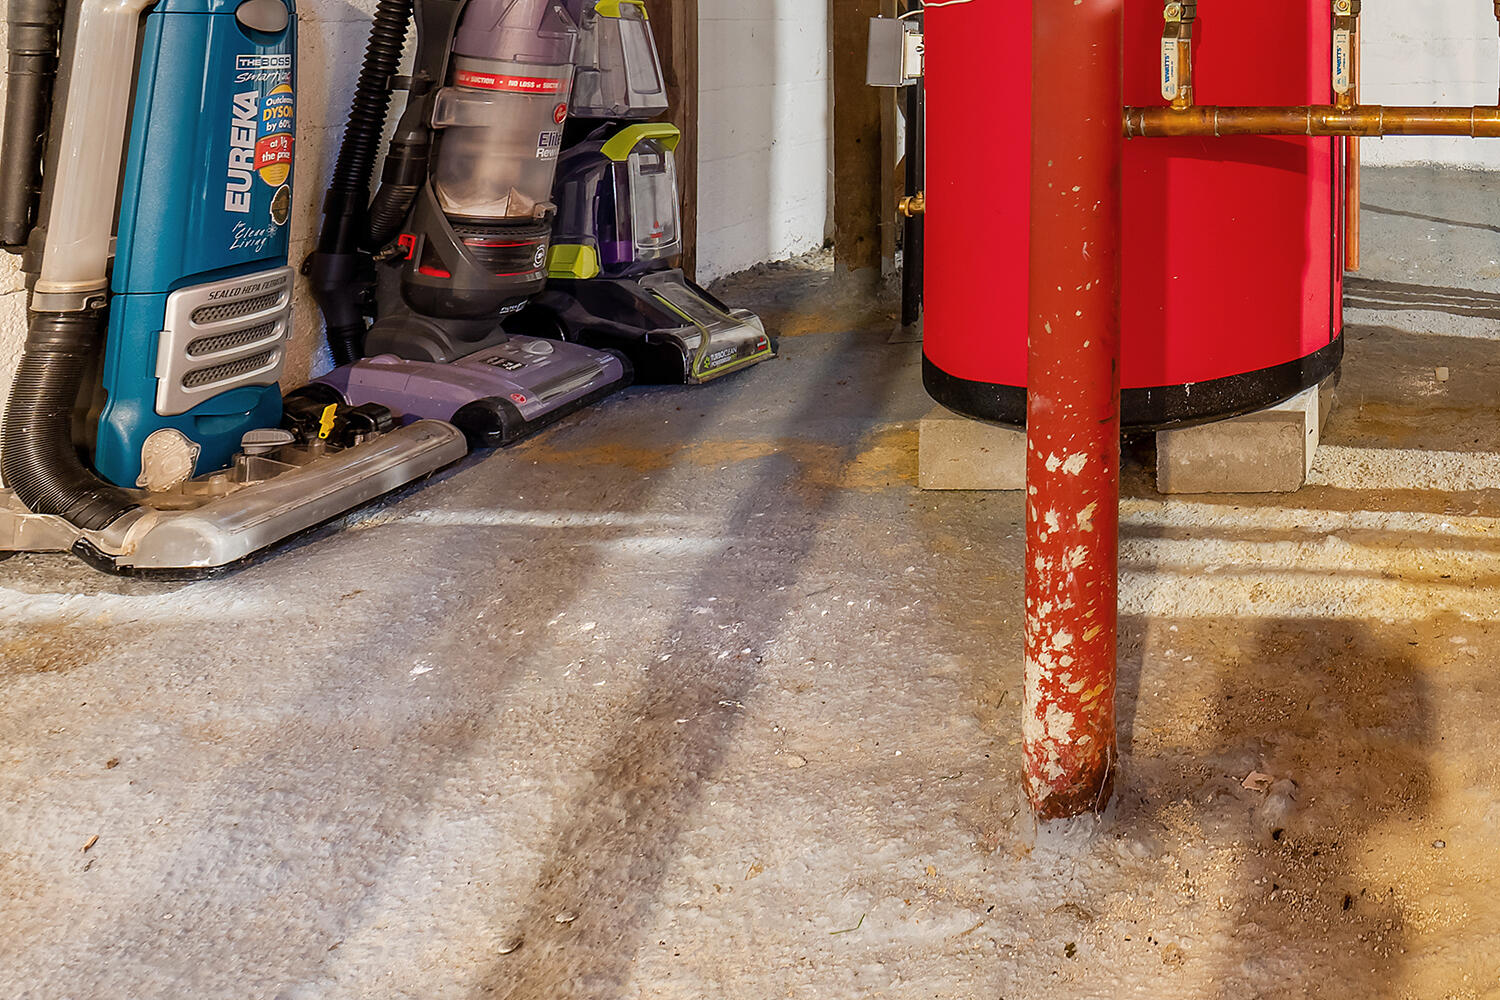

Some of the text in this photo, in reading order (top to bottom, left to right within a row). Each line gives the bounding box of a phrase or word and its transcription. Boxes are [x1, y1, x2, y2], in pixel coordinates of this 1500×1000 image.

[239, 57, 290, 67] THE BOSS
[470, 77, 495, 86] SUCTION
[508, 79, 518, 87] NO
[519, 80, 535, 89] LOSS
[263, 105, 294, 122] DYSON
[266, 122, 277, 132] by
[270, 139, 278, 148] at
[224, 90, 259, 213] EUREKA
[262, 151, 276, 162] the
[235, 227, 266, 239] Clean
[229, 237, 268, 253] Living
[208, 287, 241, 301] SEALED
[241, 283, 262, 295] HEPA
